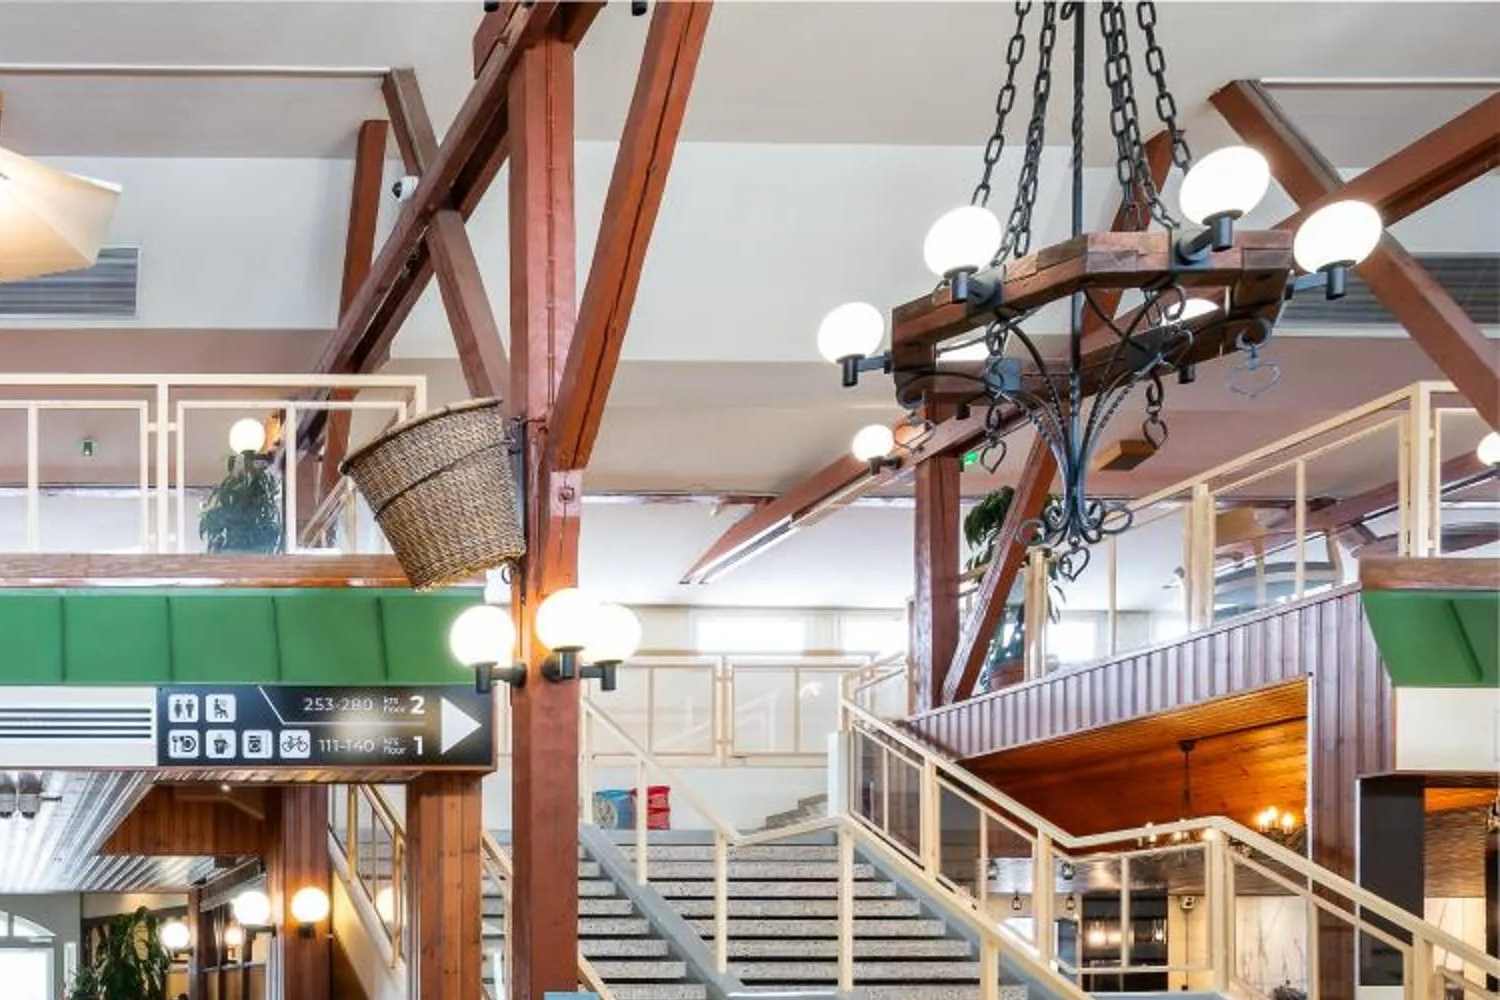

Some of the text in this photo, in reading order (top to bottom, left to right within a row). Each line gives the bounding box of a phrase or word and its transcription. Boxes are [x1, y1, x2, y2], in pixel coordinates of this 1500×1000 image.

[409, 695, 426, 714] 2
[317, 735, 424, 756] 111-140 1
